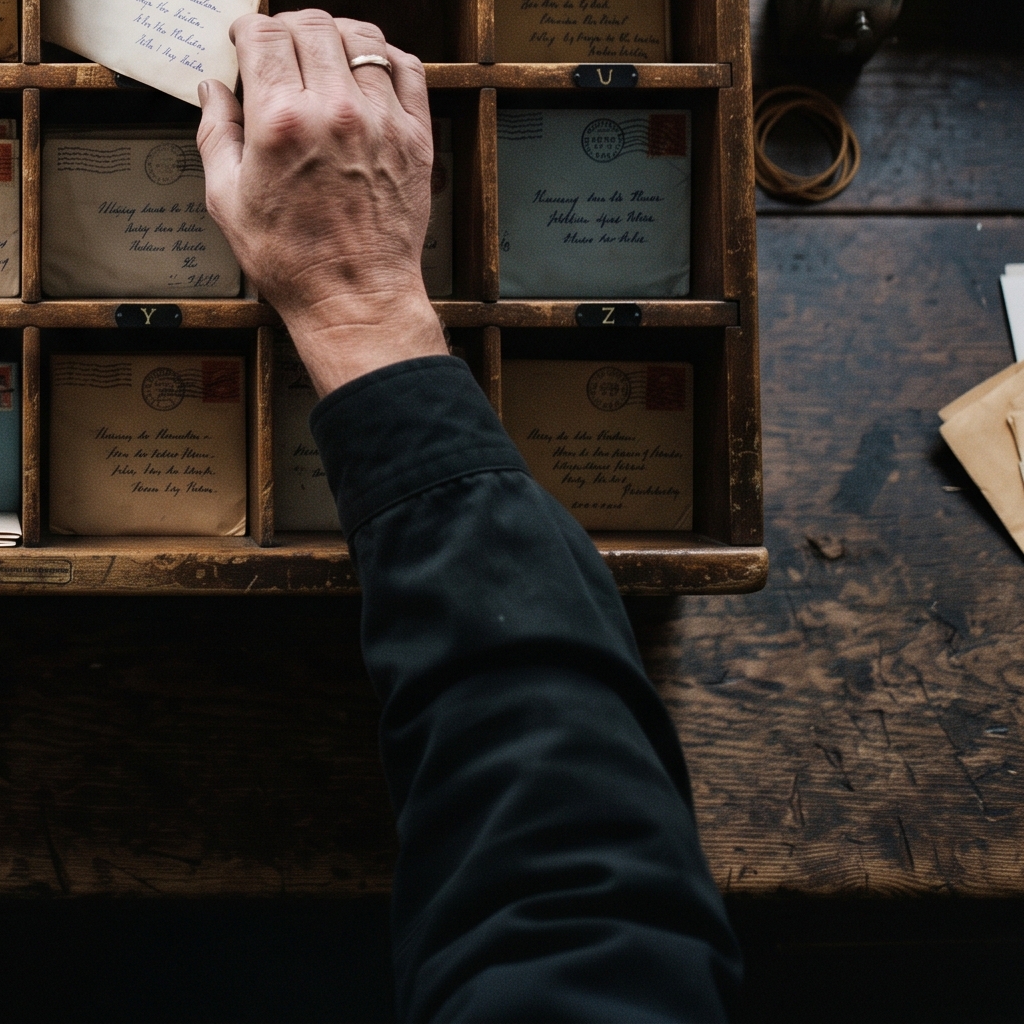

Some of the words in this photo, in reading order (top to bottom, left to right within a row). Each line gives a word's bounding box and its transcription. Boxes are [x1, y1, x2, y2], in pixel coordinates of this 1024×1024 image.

[596, 68, 613, 86] U
[140, 307, 157, 325] Y
[601, 306, 615, 325] Z
